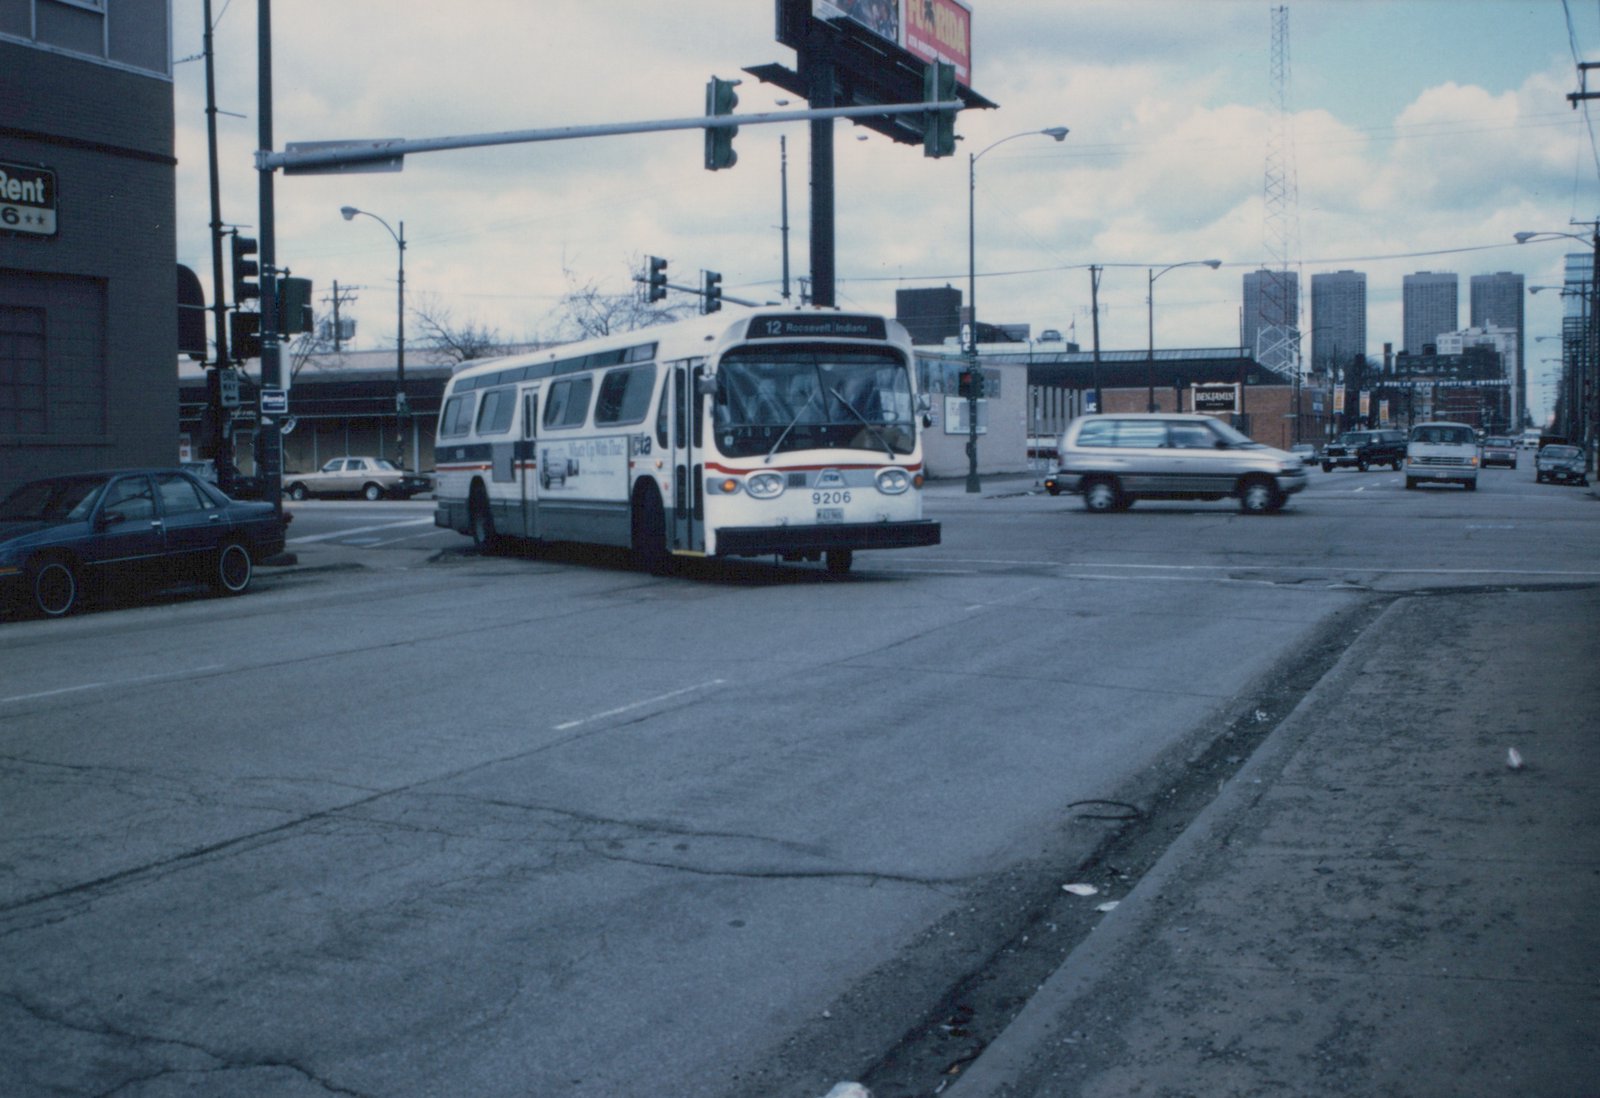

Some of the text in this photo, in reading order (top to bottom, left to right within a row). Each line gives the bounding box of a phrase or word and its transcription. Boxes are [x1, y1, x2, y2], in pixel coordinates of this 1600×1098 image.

[766, 320, 782, 335] 12
[1196, 392, 1234, 402] BENJAMIN
[631, 434, 652, 456] cta
[812, 491, 852, 505] 9206
